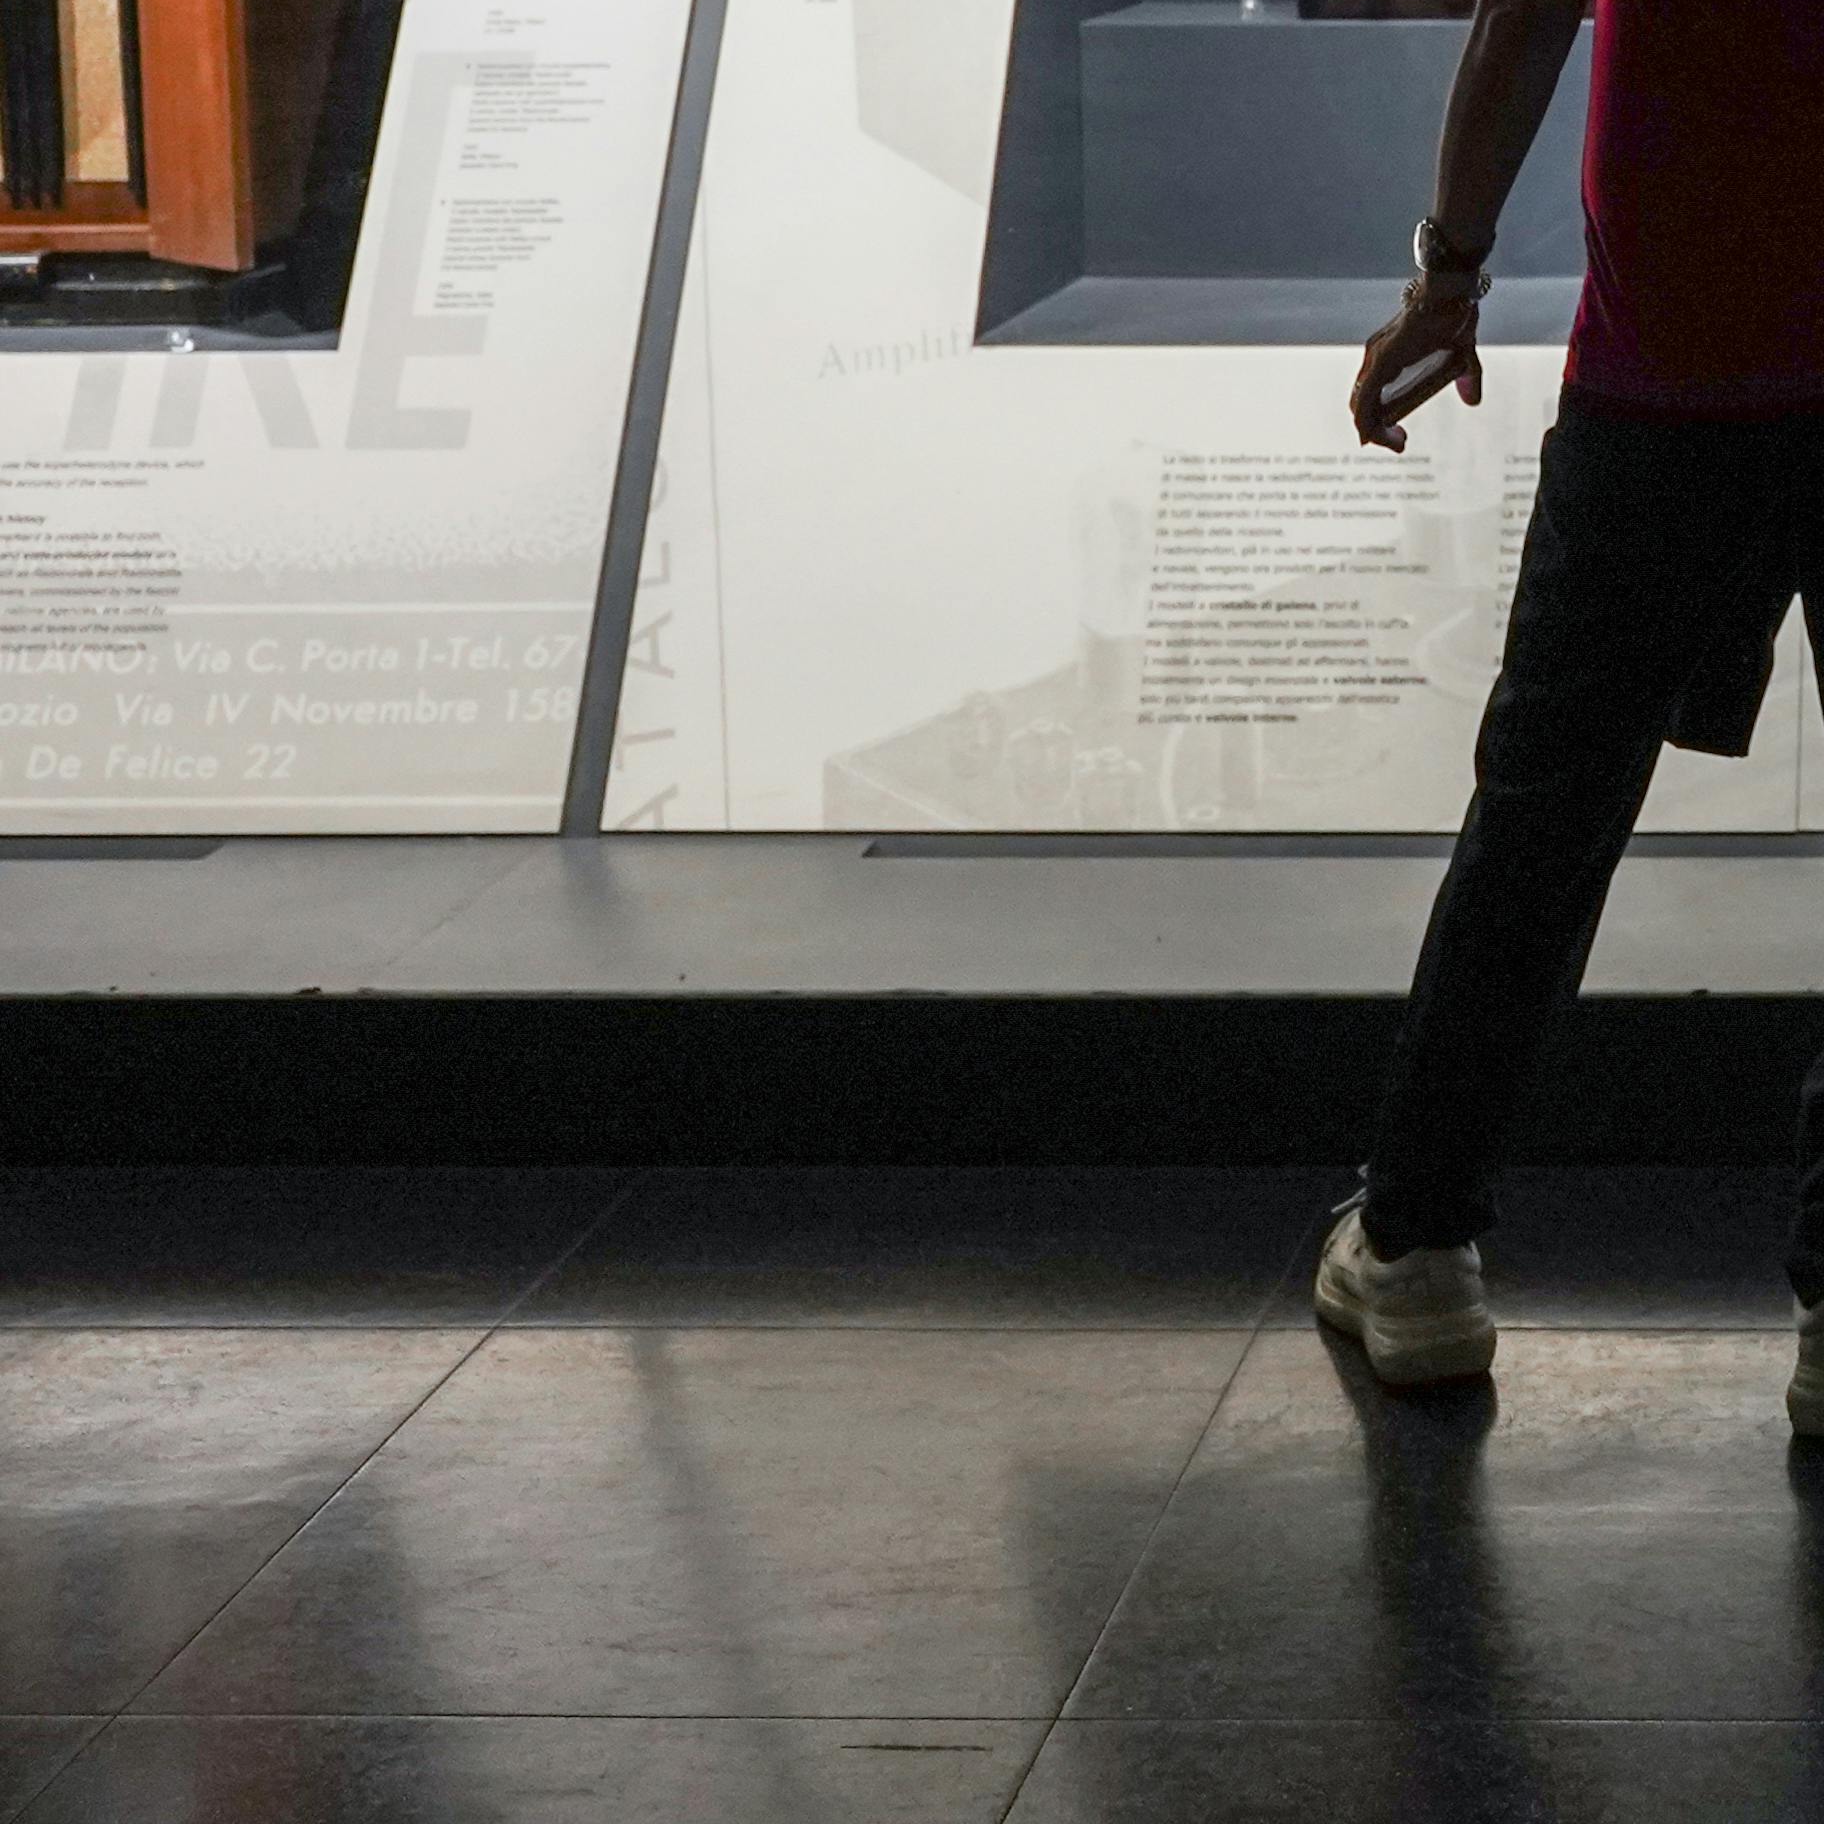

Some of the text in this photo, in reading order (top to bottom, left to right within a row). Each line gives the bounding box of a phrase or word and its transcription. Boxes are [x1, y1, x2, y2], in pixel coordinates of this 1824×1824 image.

[173, 640, 232, 674] Via
[301, 638, 400, 674] Porta
[114, 692, 175, 727] Via
[268, 690, 481, 726] Novembre
[26, 741, 298, 781] De Felice 22
